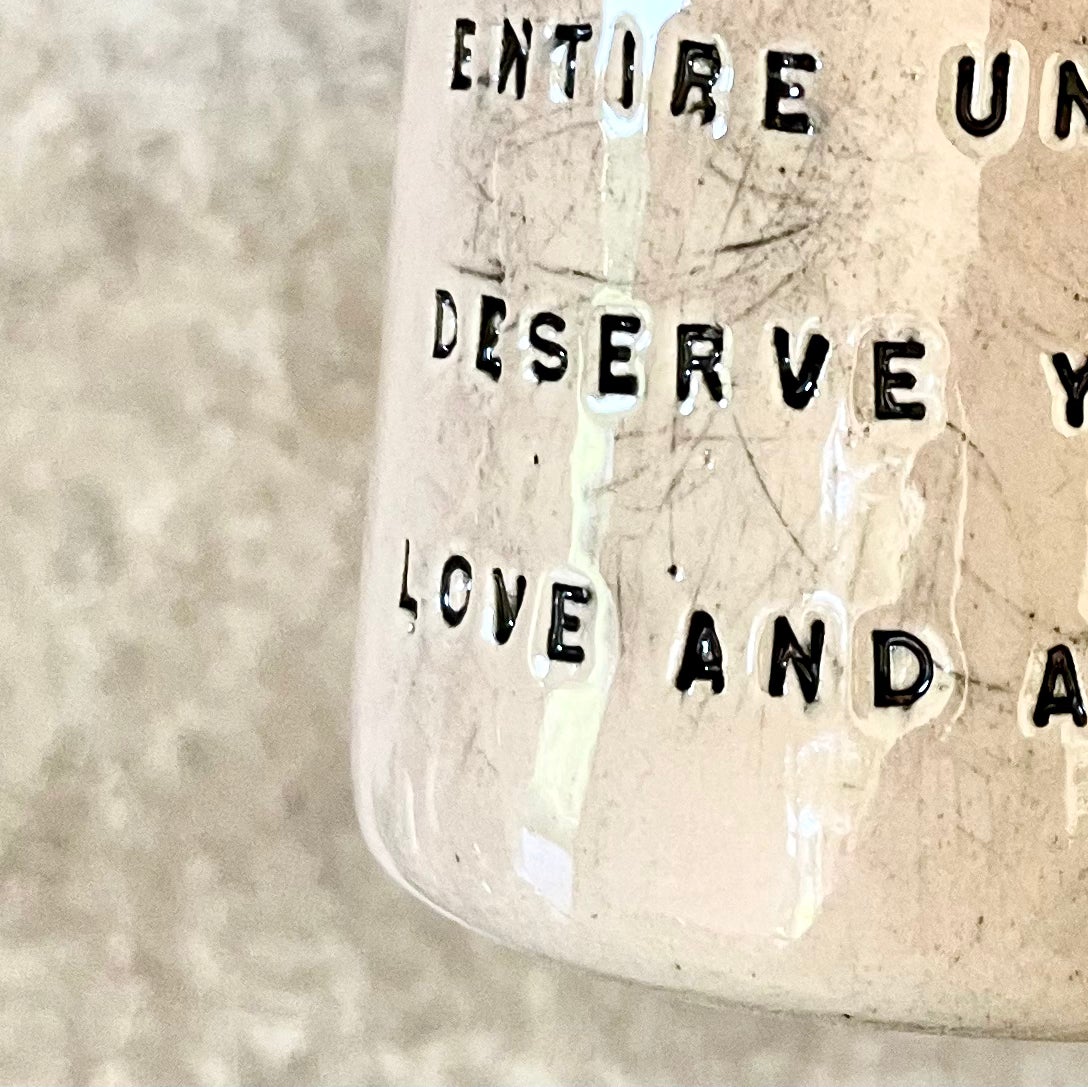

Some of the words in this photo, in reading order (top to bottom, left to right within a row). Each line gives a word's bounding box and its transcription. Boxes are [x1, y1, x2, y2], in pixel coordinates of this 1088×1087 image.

[451, 18, 817, 134] ENTIRE
[433, 289, 926, 420] DESERVE
[398, 538, 593, 662] LOVE
[676, 610, 933, 708] AND
